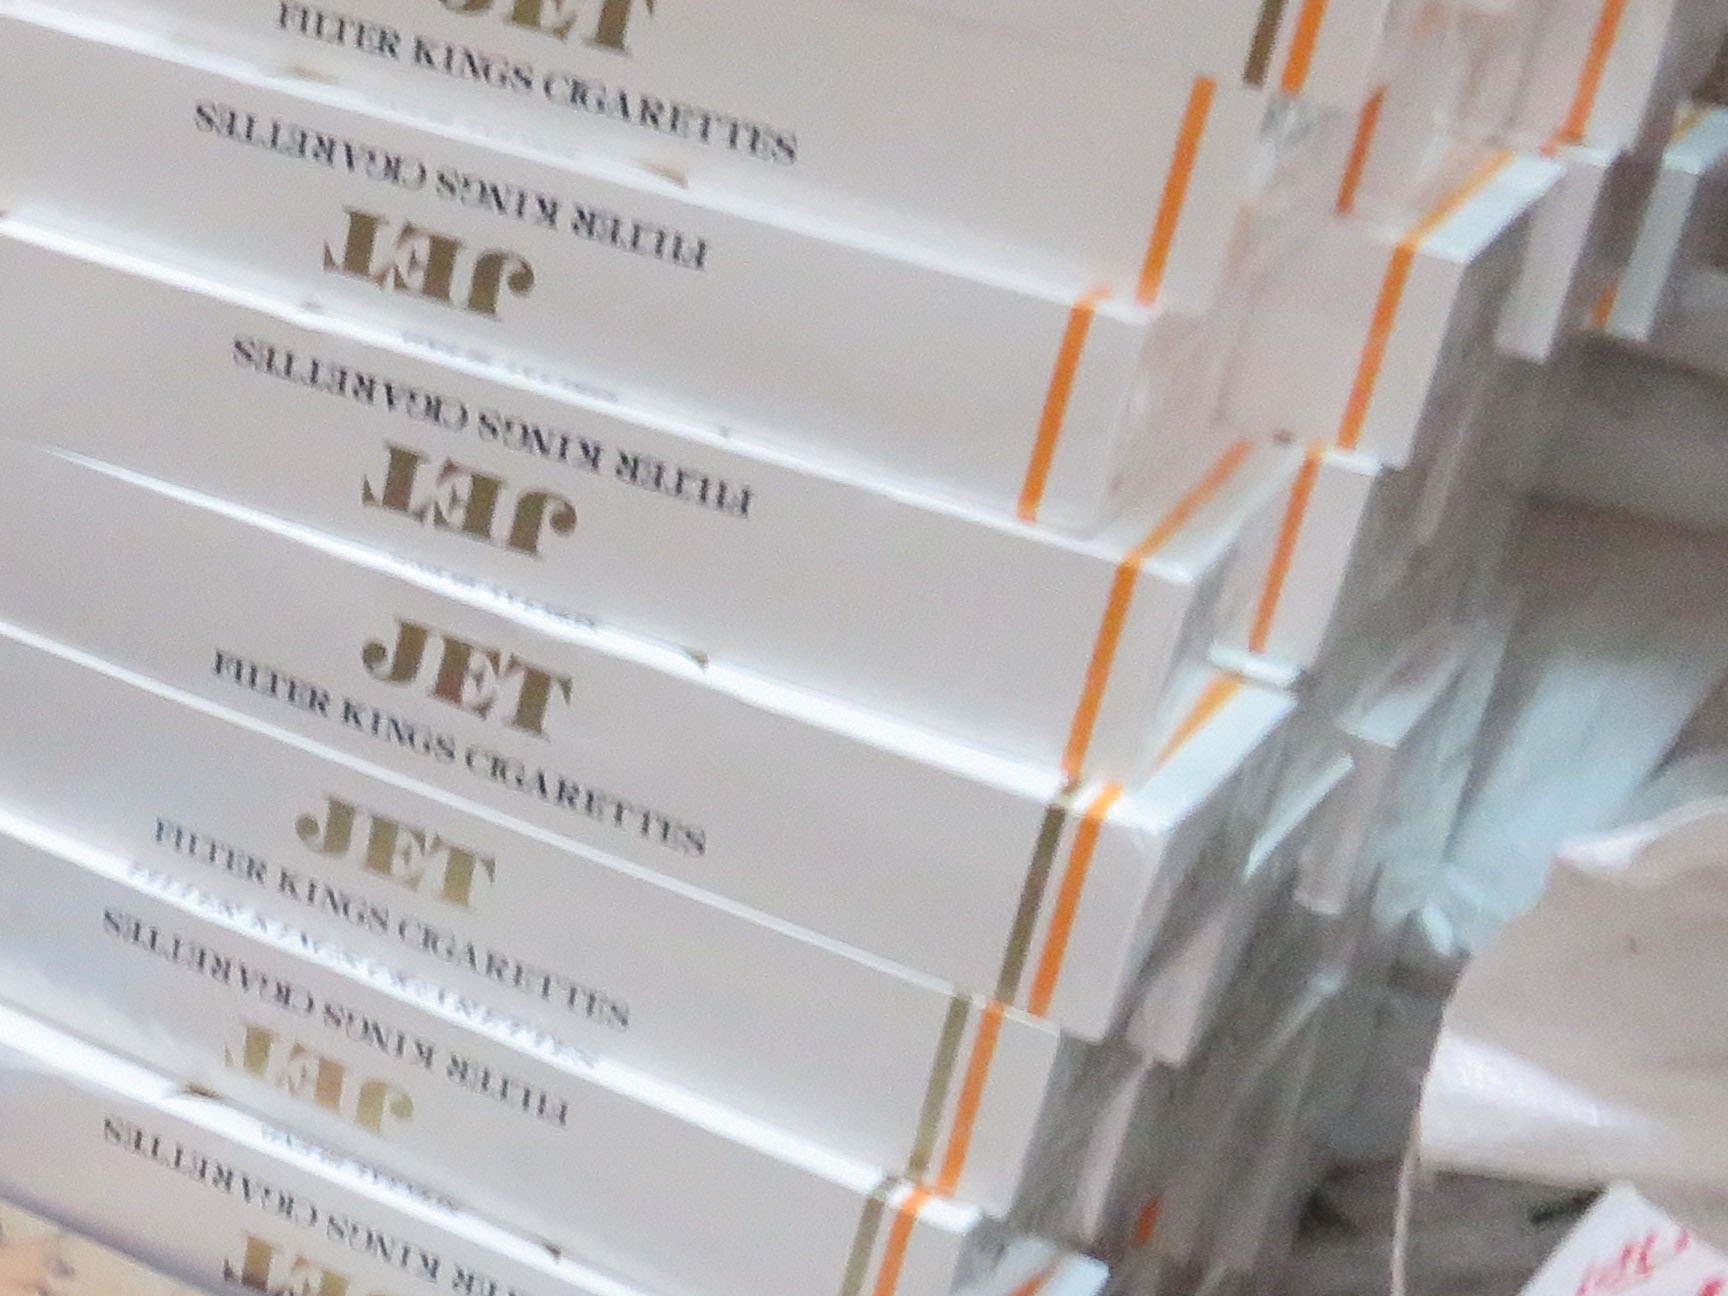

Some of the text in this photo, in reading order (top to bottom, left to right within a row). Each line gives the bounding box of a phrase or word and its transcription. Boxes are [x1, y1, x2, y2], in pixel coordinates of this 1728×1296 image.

[411, 35, 535, 94] KINGS
[541, 73, 799, 166] CIGARETTES
[193, 102, 710, 273] FILTER KINGS CIGARETTES
[323, 206, 535, 320] JET
[231, 336, 471, 432] CIGARETTES
[362, 440, 576, 557] JET
[476, 410, 605, 476] KINGS
[613, 448, 755, 521] FILTER
[363, 616, 573, 740] JET
[211, 648, 708, 859] FILTER KINGS CIGARETTES
[295, 795, 495, 910] JET
[153, 817, 631, 1031] FILTER KINGS CIGARETTES
[102, 908, 570, 1129] FILTER KINGS CIGARETTES
[224, 1023, 414, 1137] JET
[102, 1117, 320, 1229] CIGARETTES
[326, 1214, 442, 1285] KINGS
